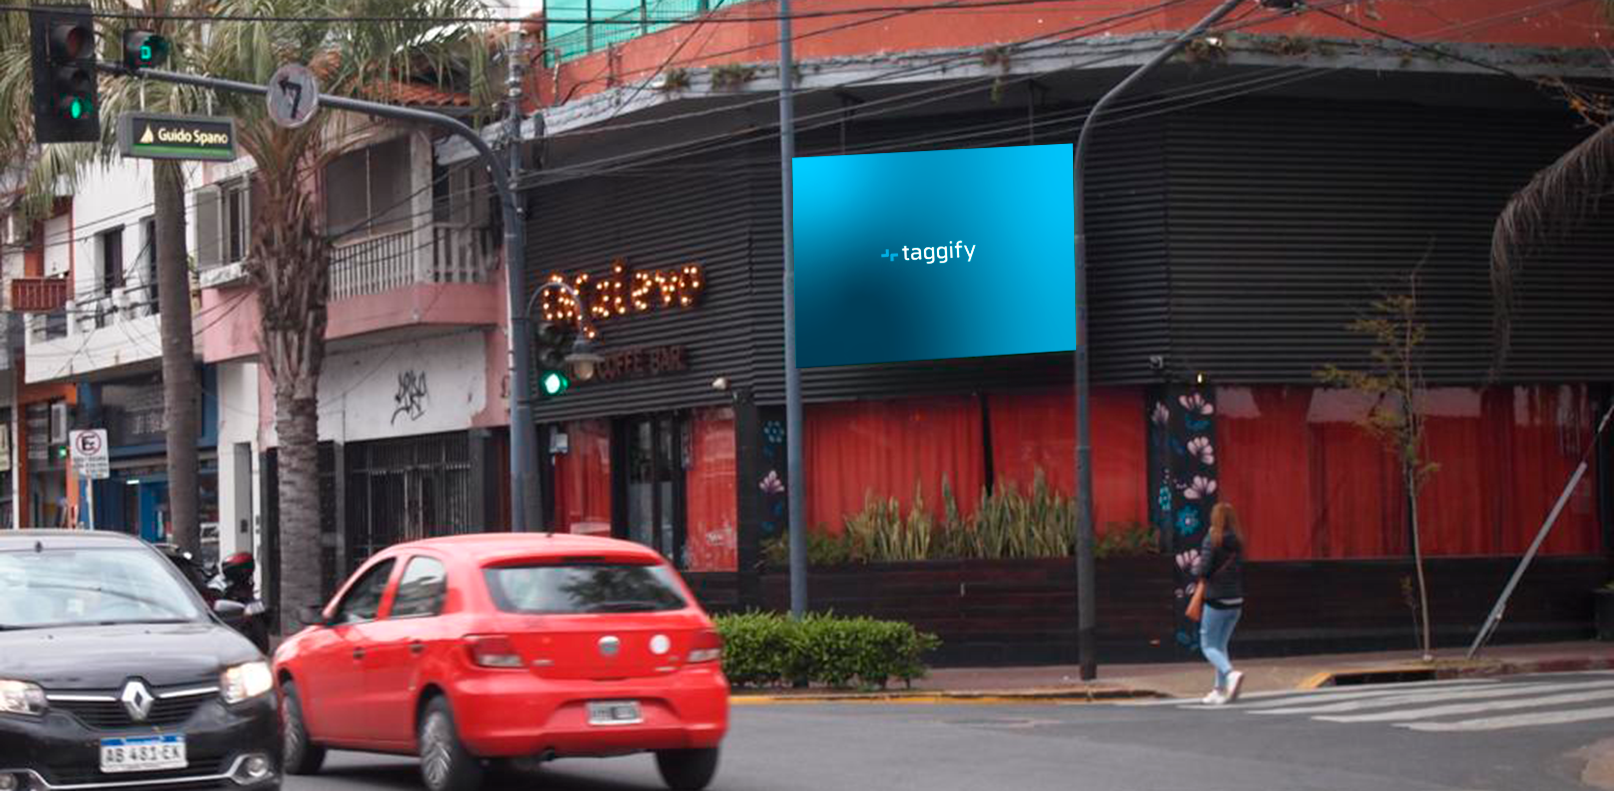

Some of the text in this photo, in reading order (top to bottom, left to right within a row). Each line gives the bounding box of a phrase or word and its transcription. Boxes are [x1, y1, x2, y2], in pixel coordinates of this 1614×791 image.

[158, 127, 228, 146] Guido Spano
[902, 240, 976, 264] taggify
